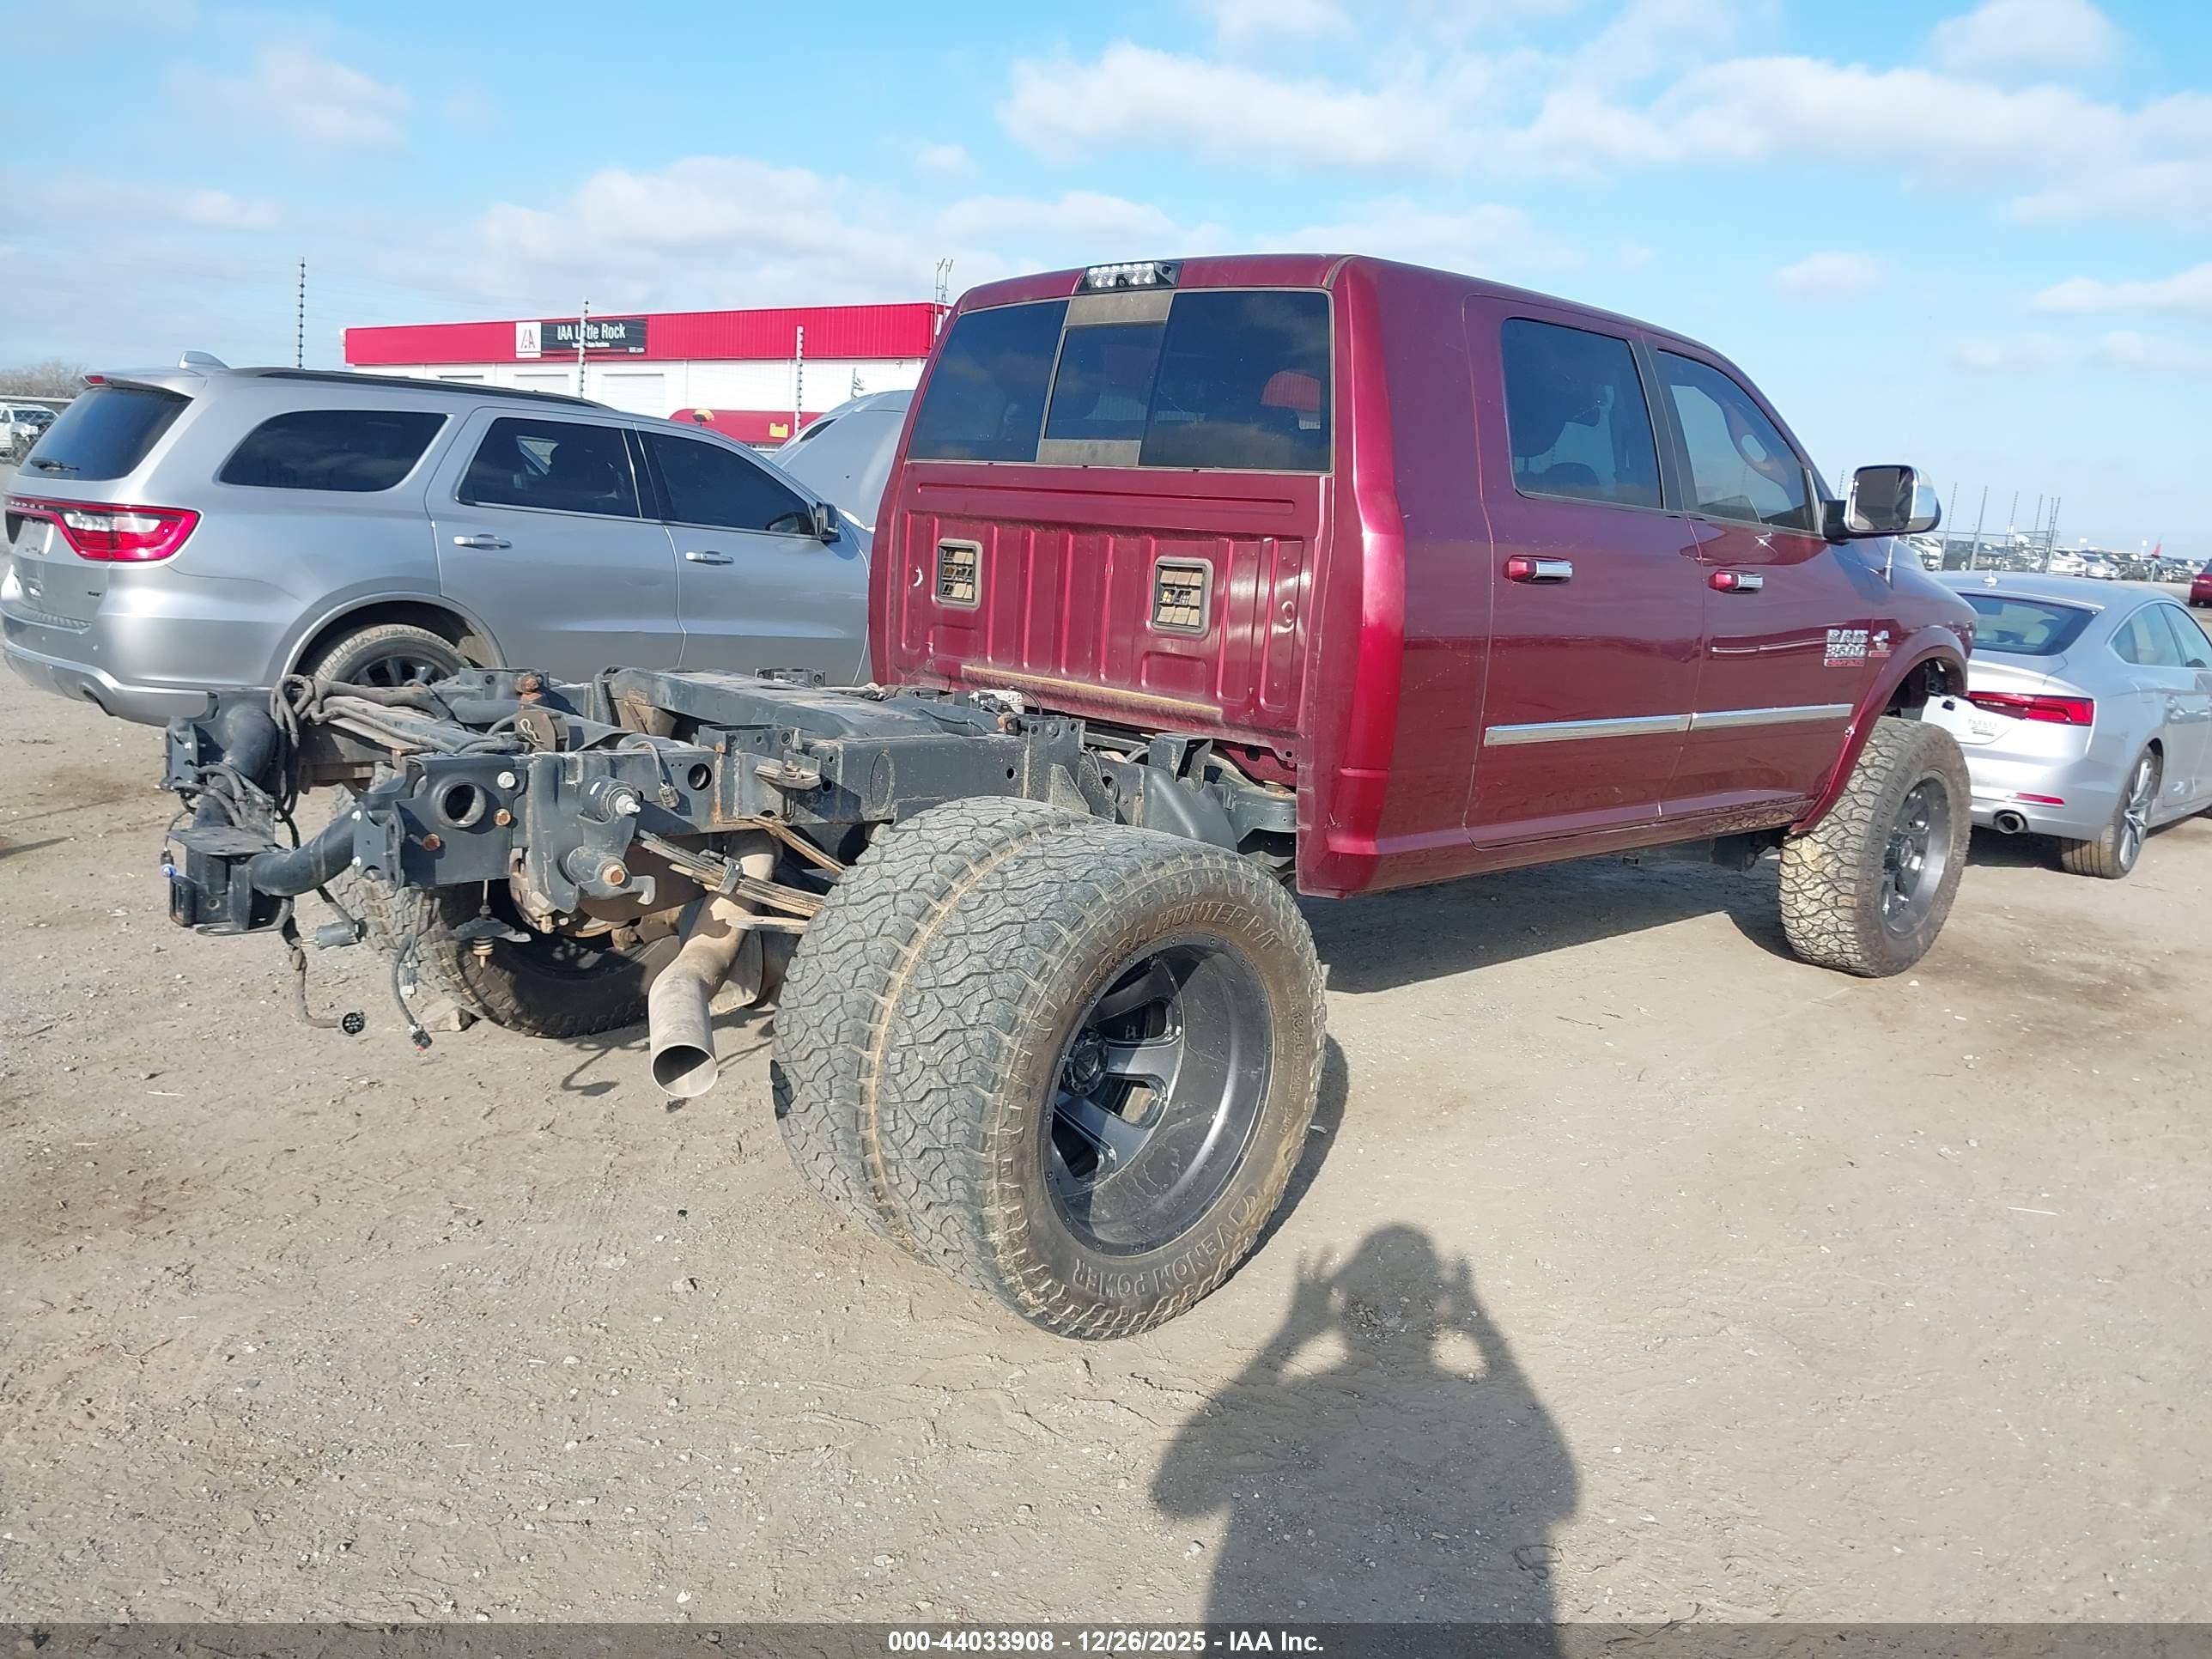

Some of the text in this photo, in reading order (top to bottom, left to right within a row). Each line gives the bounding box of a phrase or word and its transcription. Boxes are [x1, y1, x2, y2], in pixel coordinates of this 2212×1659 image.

[557, 325, 573, 340] IAA
[602, 323, 626, 339] Rock
[1154, 901, 1247, 934] HUNTER
[1242, 915, 1283, 950] R/T
[1073, 1222, 1238, 1299] VENOM POWER
